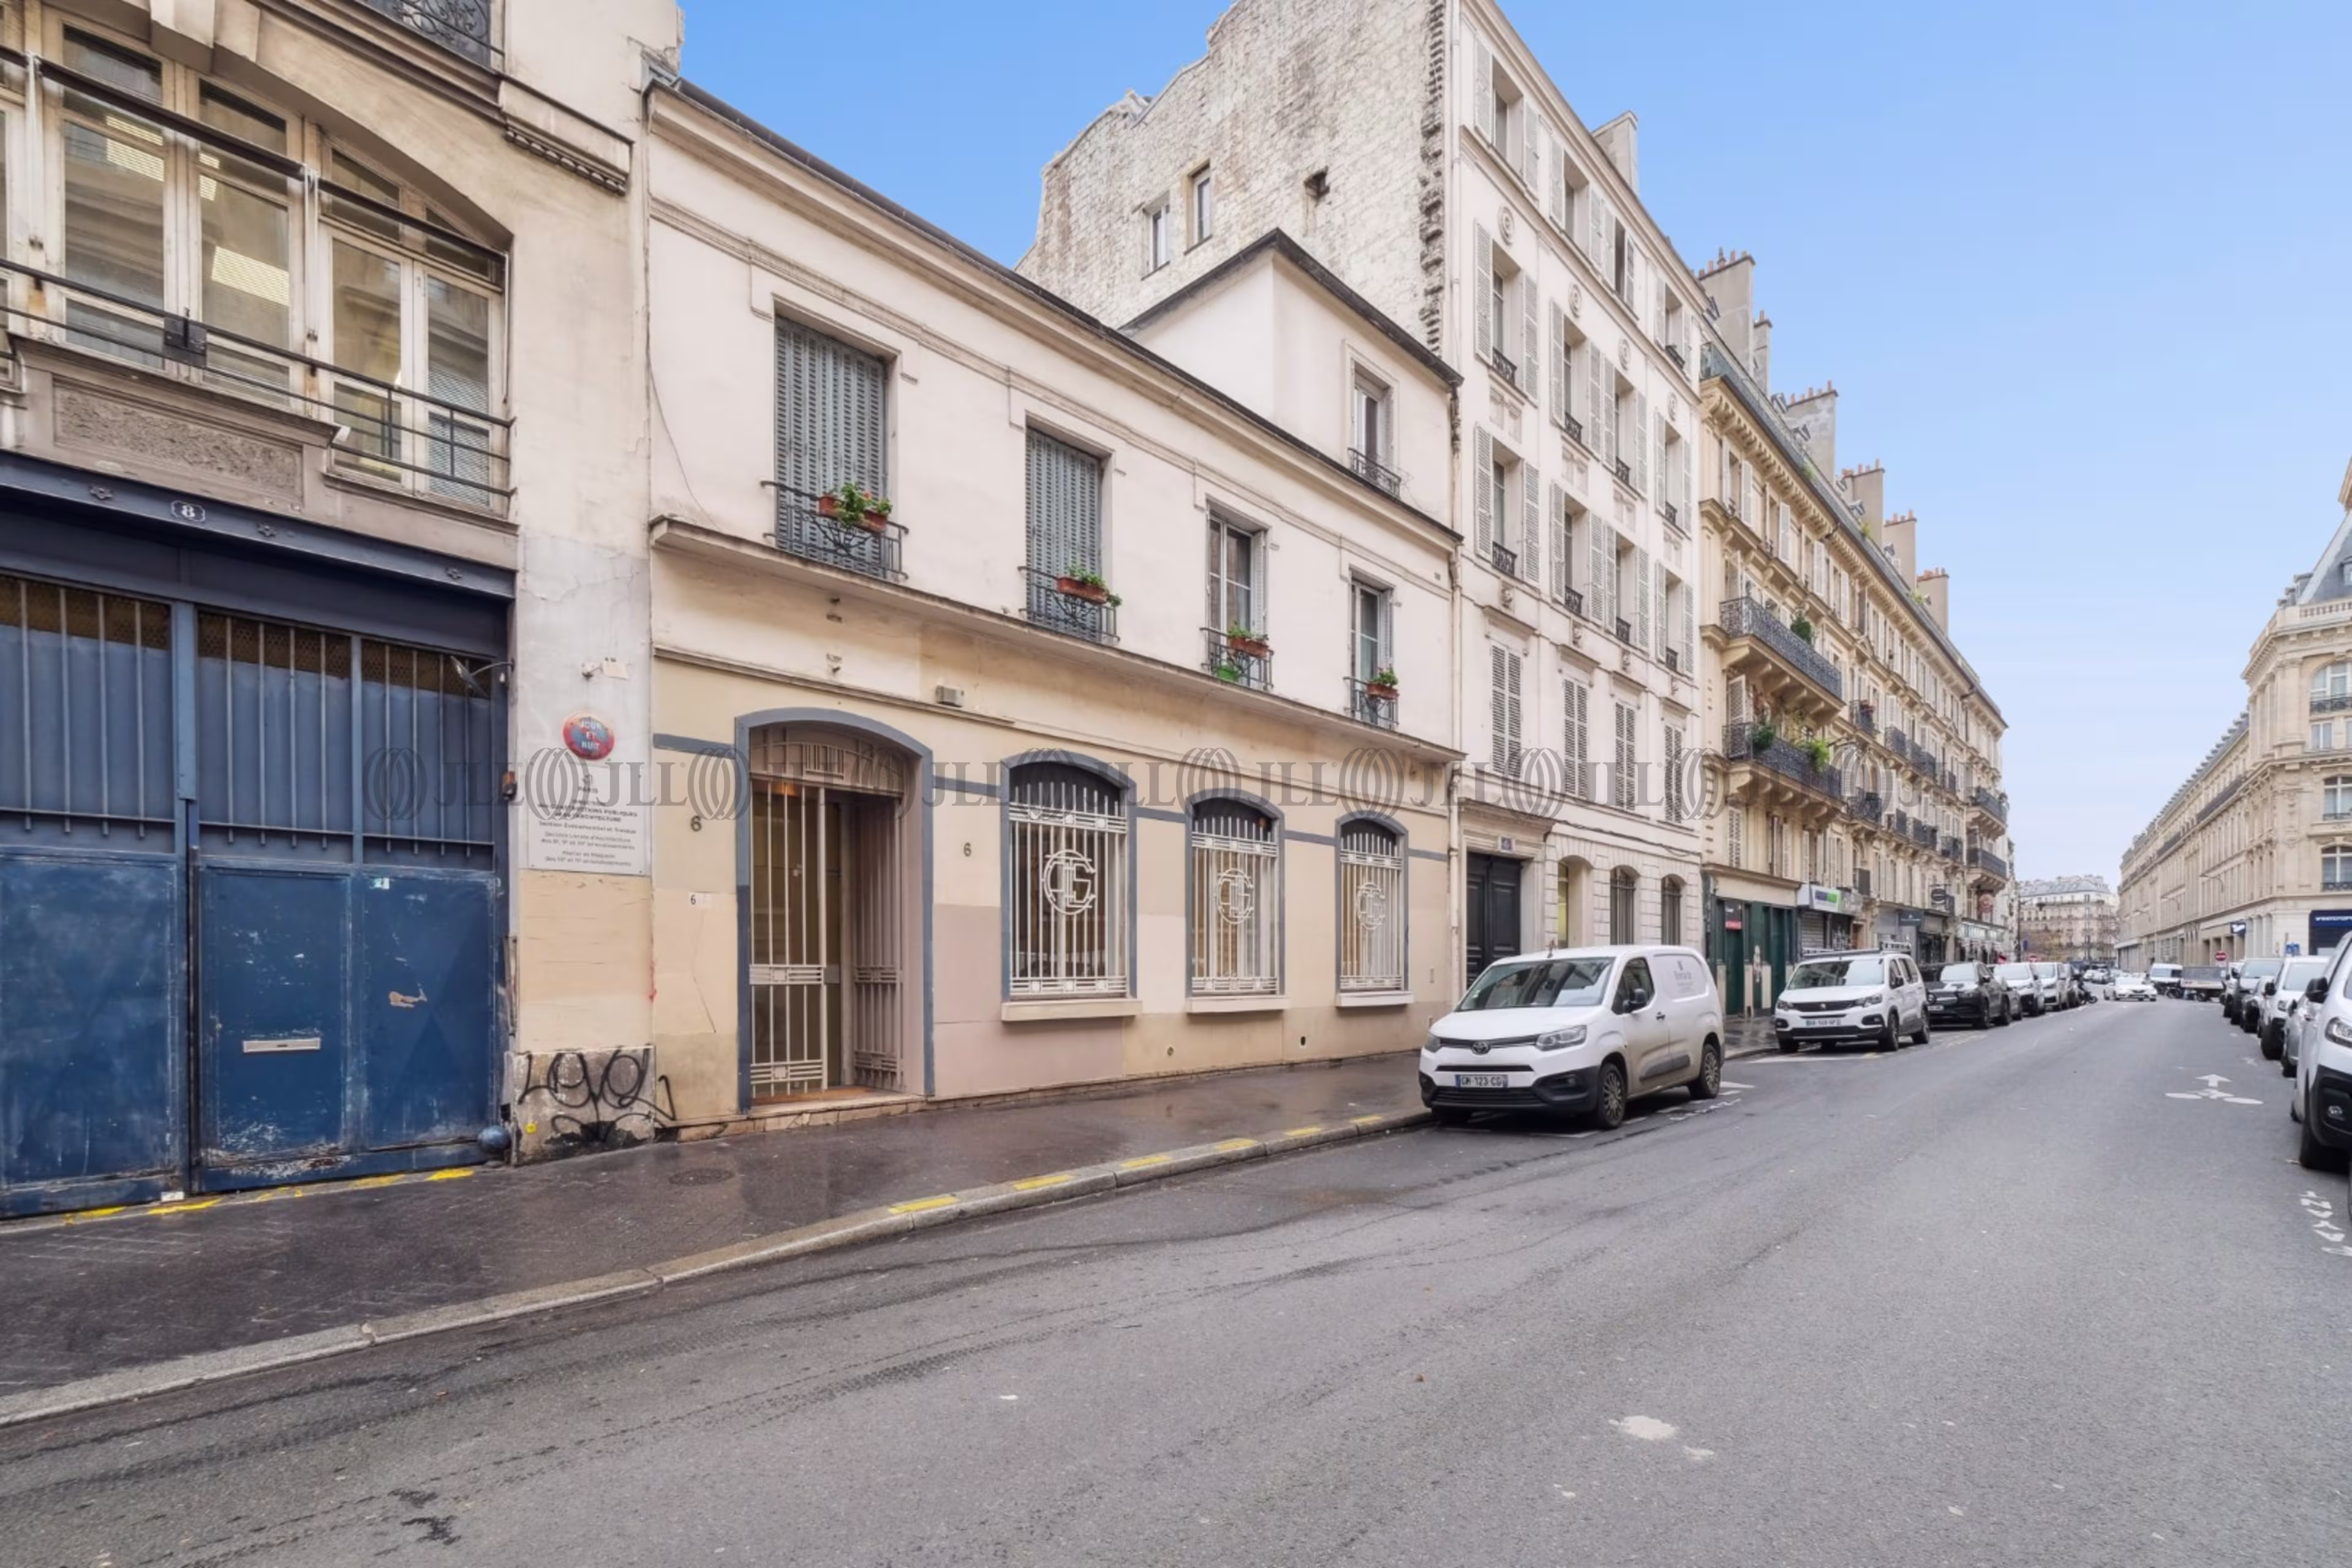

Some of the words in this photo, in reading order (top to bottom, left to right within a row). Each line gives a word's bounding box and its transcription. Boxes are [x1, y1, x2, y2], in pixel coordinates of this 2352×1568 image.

[181, 505, 195, 518] 8
[580, 721, 601, 730] JOUR
[582, 741, 600, 749] NUIT
[690, 815, 702, 832] 6
[963, 842, 972, 857] 6
[690, 894, 696, 905] 6
